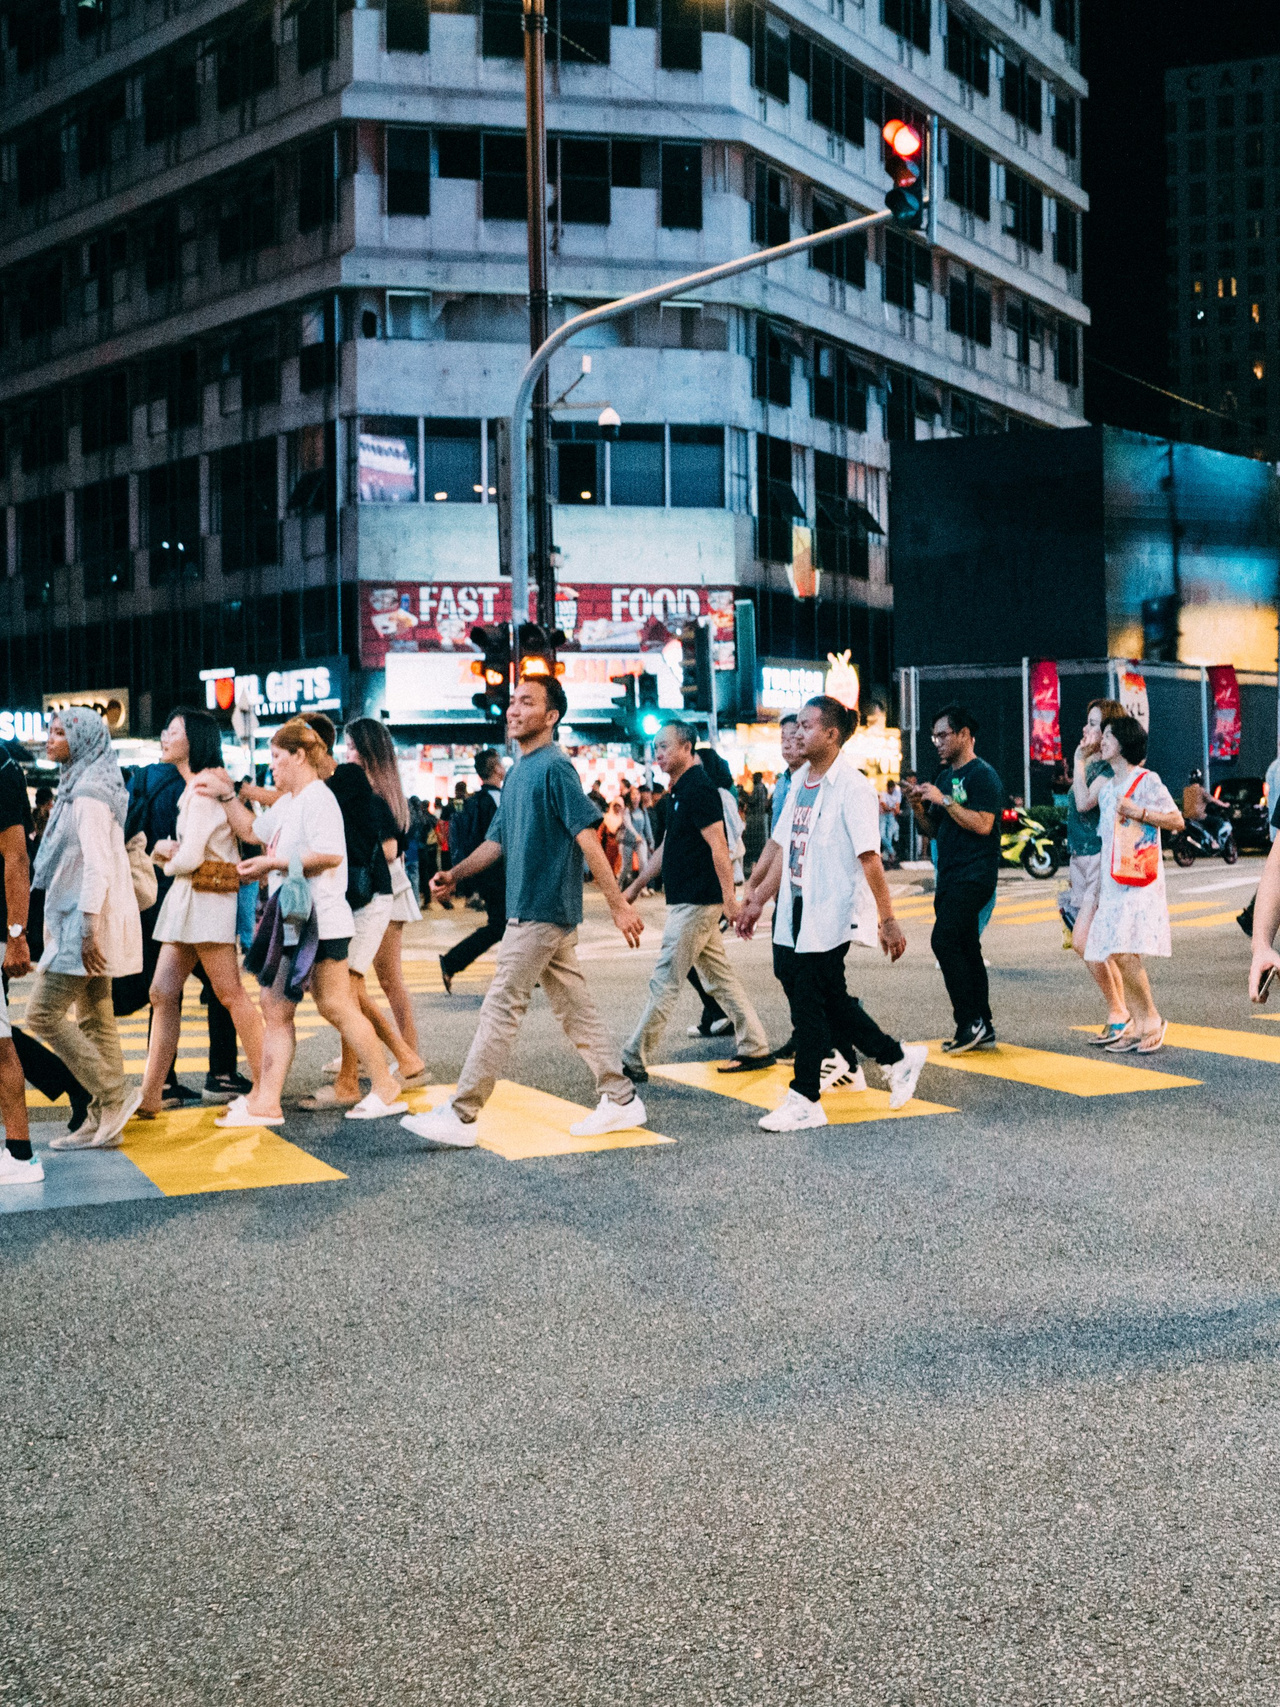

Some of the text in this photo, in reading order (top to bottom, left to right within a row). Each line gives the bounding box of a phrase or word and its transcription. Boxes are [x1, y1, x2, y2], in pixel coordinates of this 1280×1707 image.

[418, 586, 701, 623] FAST FOOD
[265, 666, 331, 703] GIFTS
